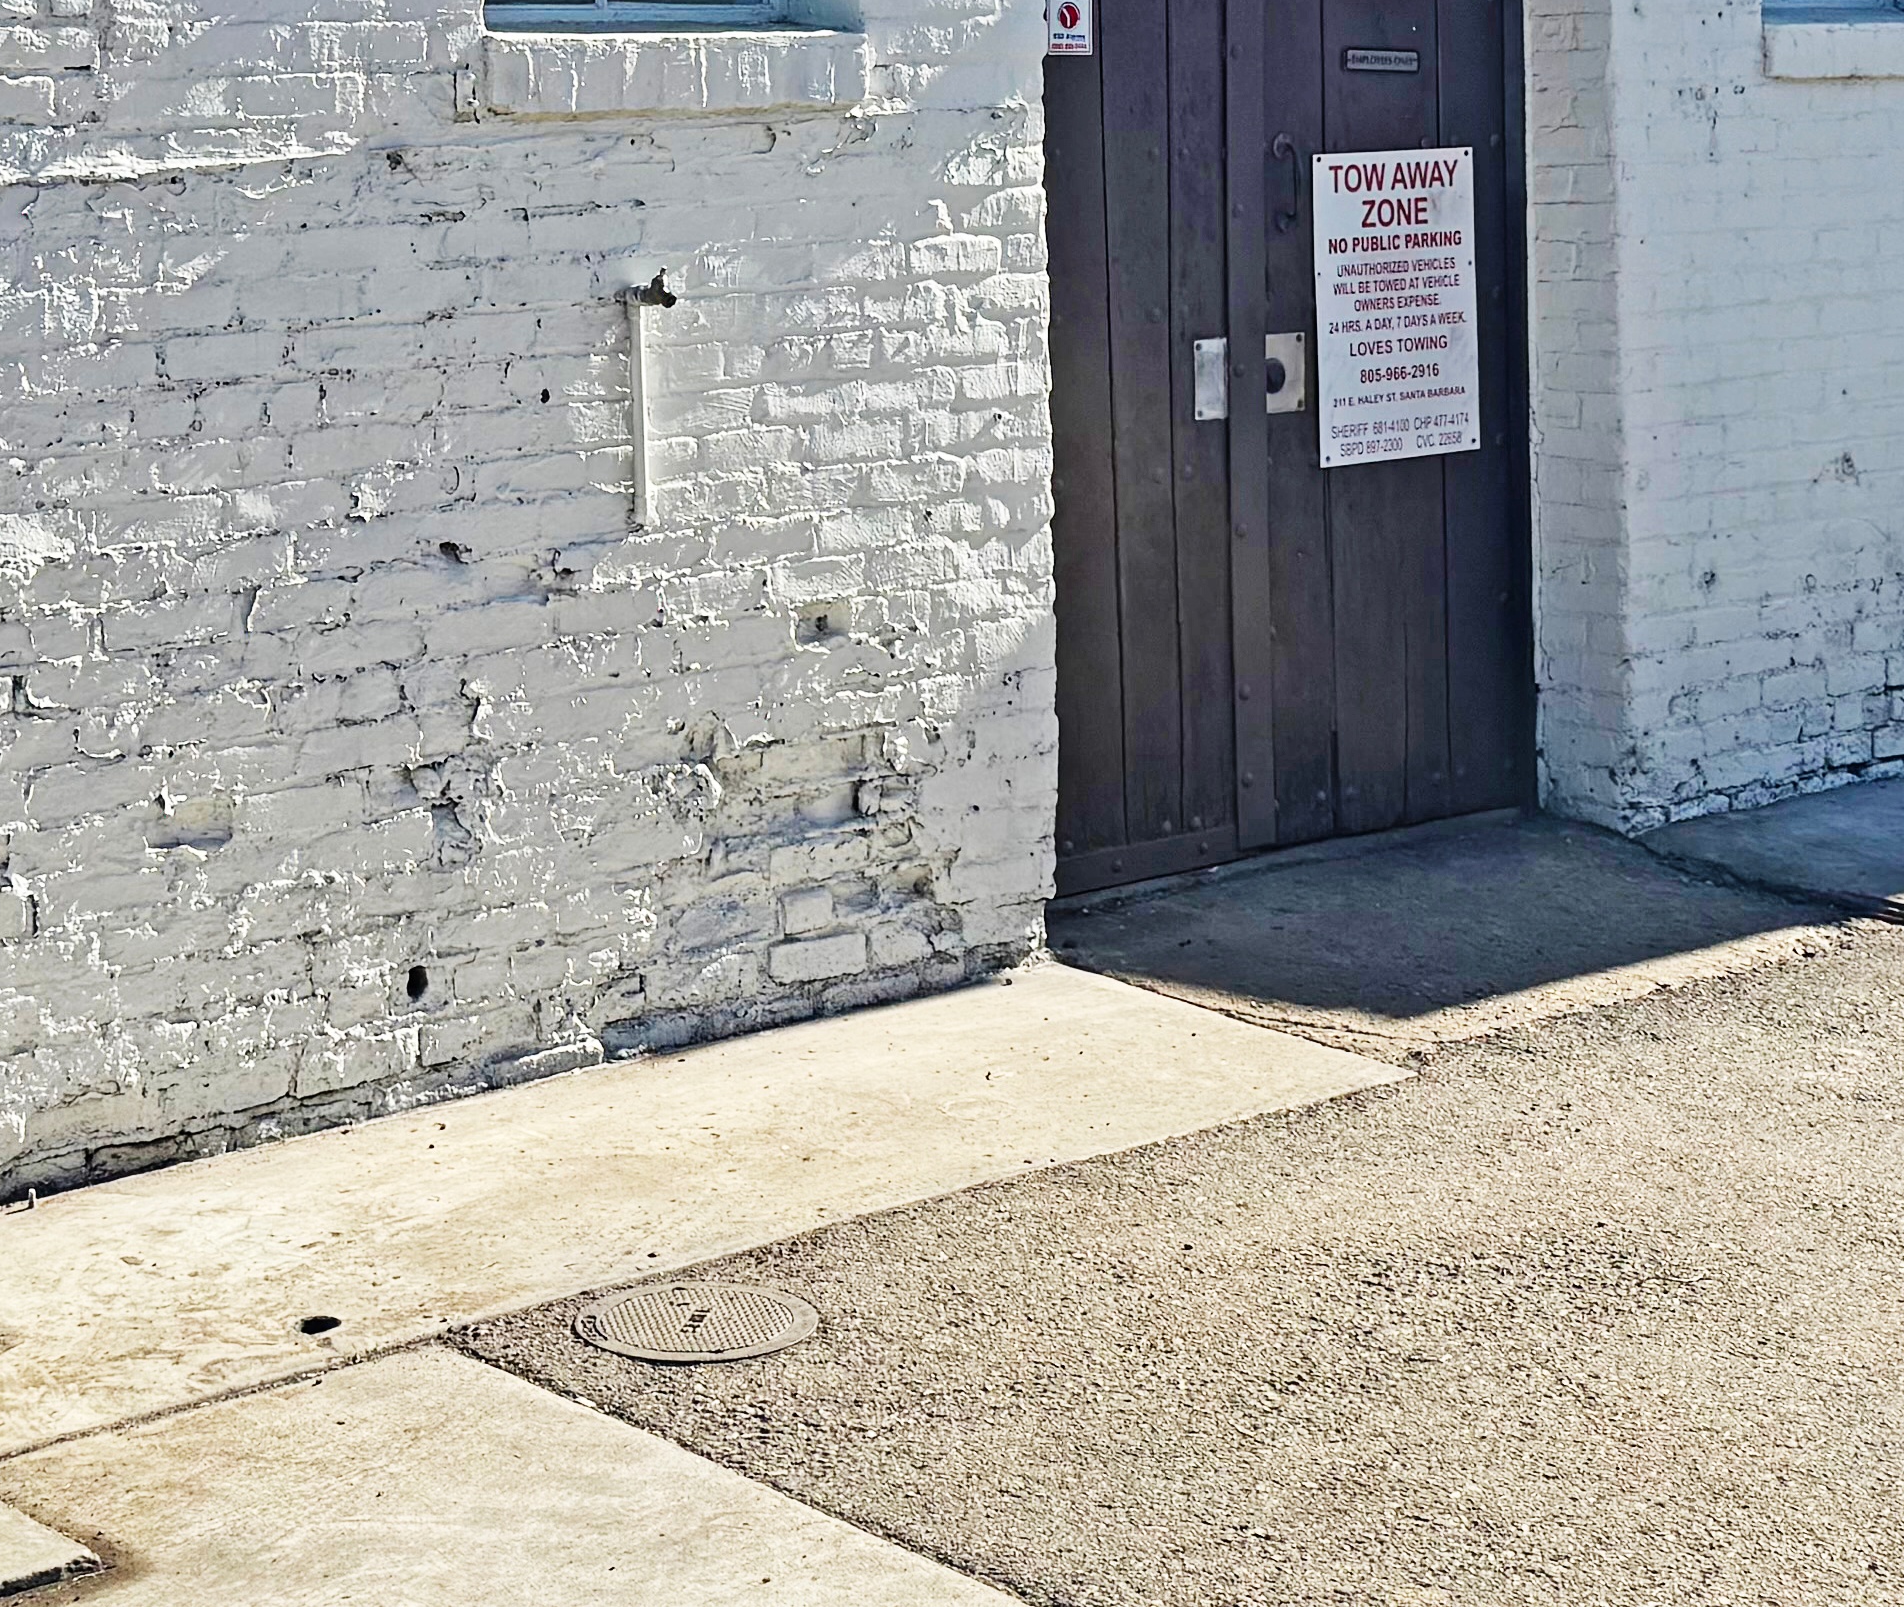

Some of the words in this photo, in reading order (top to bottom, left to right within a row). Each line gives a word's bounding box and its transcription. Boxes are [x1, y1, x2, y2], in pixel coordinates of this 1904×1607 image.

[1328, 162, 1386, 193] TOW
[1391, 159, 1458, 190] AWAY
[1361, 197, 1428, 228] ZONE
[1328, 238, 1348, 254] NO
[1352, 234, 1401, 252] PUBLIC
[1404, 230, 1462, 249] PARKING
[1337, 260, 1409, 277] UNAUTHORIZED
[1411, 257, 1456, 272] VEHICLES
[1333, 282, 1356, 296] WILL
[1358, 280, 1371, 294] BE
[1373, 277, 1406, 292] TOWED
[1408, 276, 1420, 290] AT
[1422, 274, 1460, 288] VEHICLE
[1354, 296, 1395, 312] OWNERS
[1329, 322, 1339, 334] 24
[1365, 319, 1372, 331] A
[1374, 317, 1395, 331] DAY,
[1397, 316, 1402, 328] 7
[1404, 314, 1428, 328] DAYS
[1430, 313, 1436, 325] A
[1349, 340, 1393, 357] LOVES
[1397, 335, 1448, 353] TOWING
[1360, 363, 1440, 383] 805-966-2916
[1358, 394, 1384, 405] HALEY
[1400, 390, 1426, 401] SANTA
[1427, 386, 1466, 398] BARBARA
[1331, 423, 1368, 439] SHERIFF
[1414, 416, 1432, 430] CHP
